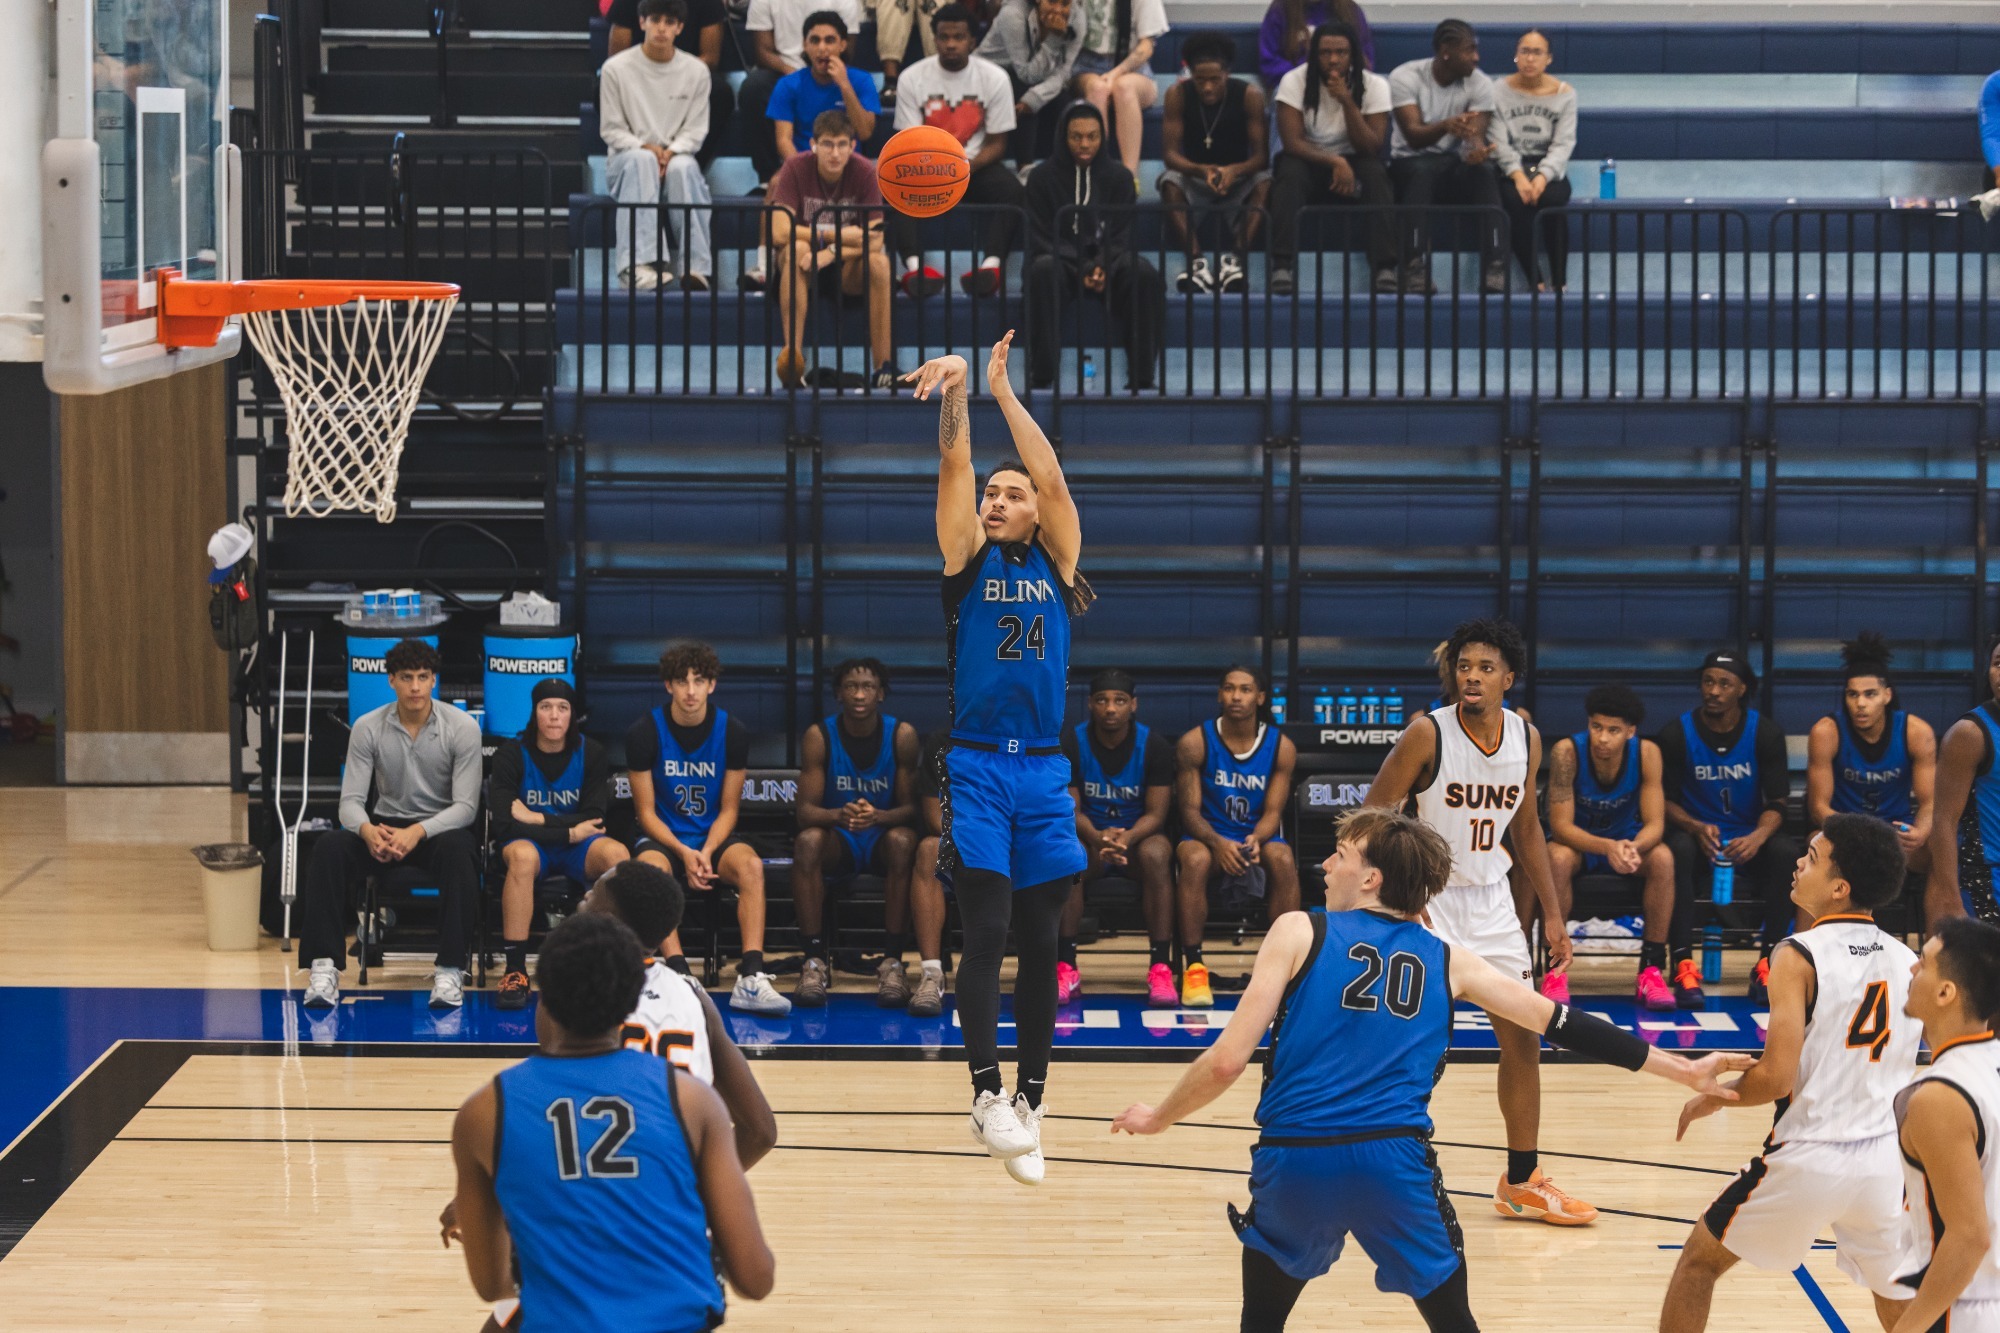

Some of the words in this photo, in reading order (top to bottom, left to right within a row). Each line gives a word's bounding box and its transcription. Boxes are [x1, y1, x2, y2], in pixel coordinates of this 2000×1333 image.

[895, 163, 957, 179] SPALDING
[900, 190, 954, 202] LEGACY
[983, 579, 1057, 604] BLINN
[997, 615, 1046, 660] 24
[352, 657, 388, 673] POWE
[490, 657, 565, 674] POWERADE
[1007, 739, 1019, 753] B
[1320, 730, 1404, 744] POWER
[664, 760, 716, 778] BLINN
[1695, 762, 1752, 780] BLINN
[836, 775, 888, 793] BLINN
[1214, 769, 1266, 791] BLINN
[526, 789, 580, 807] BLINN
[674, 784, 707, 816] 25
[1084, 781, 1139, 800] BLINN
[1444, 782, 1520, 811] SUNS
[1224, 794, 1250, 825] 10
[1720, 787, 1732, 815] 1
[1469, 818, 1495, 852] 10
[1341, 942, 1426, 1021] 20
[1845, 980, 1892, 1062] 4
[546, 1095, 639, 1180] 12
